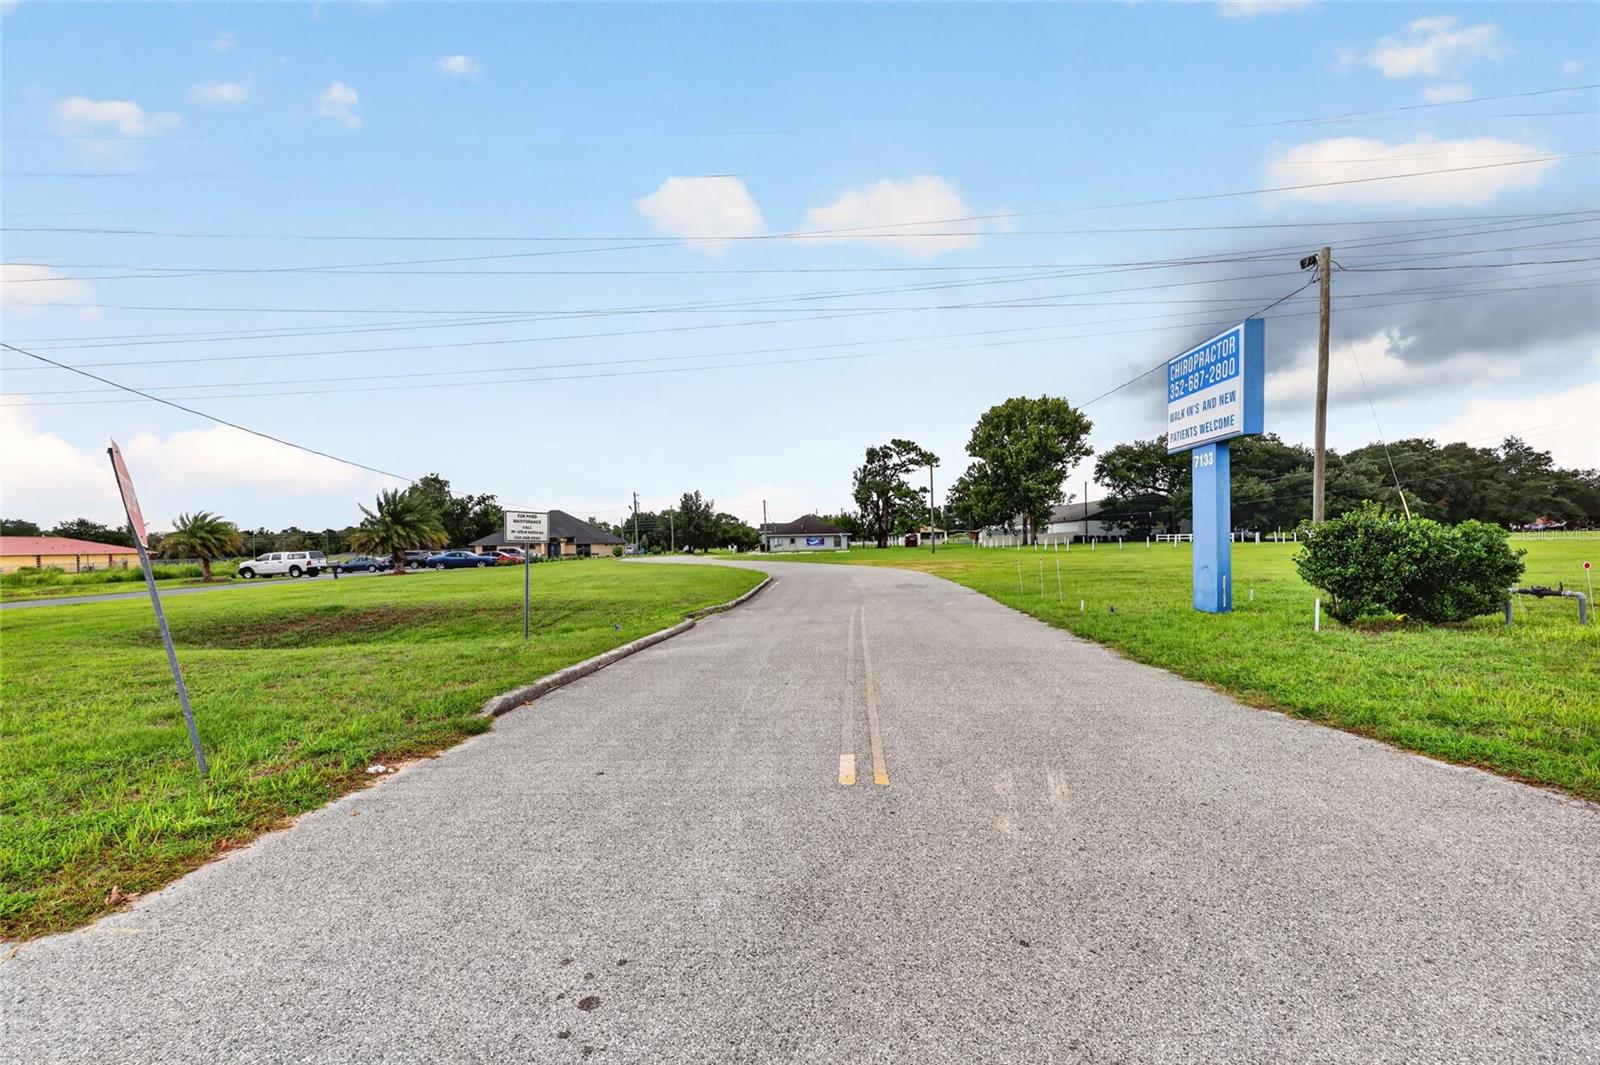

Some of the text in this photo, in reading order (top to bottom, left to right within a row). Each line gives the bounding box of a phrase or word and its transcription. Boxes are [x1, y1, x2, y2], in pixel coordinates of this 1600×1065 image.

[1170, 335, 1236, 381] CHIROPRACTOR
[1169, 357, 1235, 400] 352-687-2800
[1169, 389, 1237, 423] WALK IN'S AND NEW
[1169, 414, 1235, 443] PATIENTS WELCOME
[1194, 451, 1214, 468] 7133
